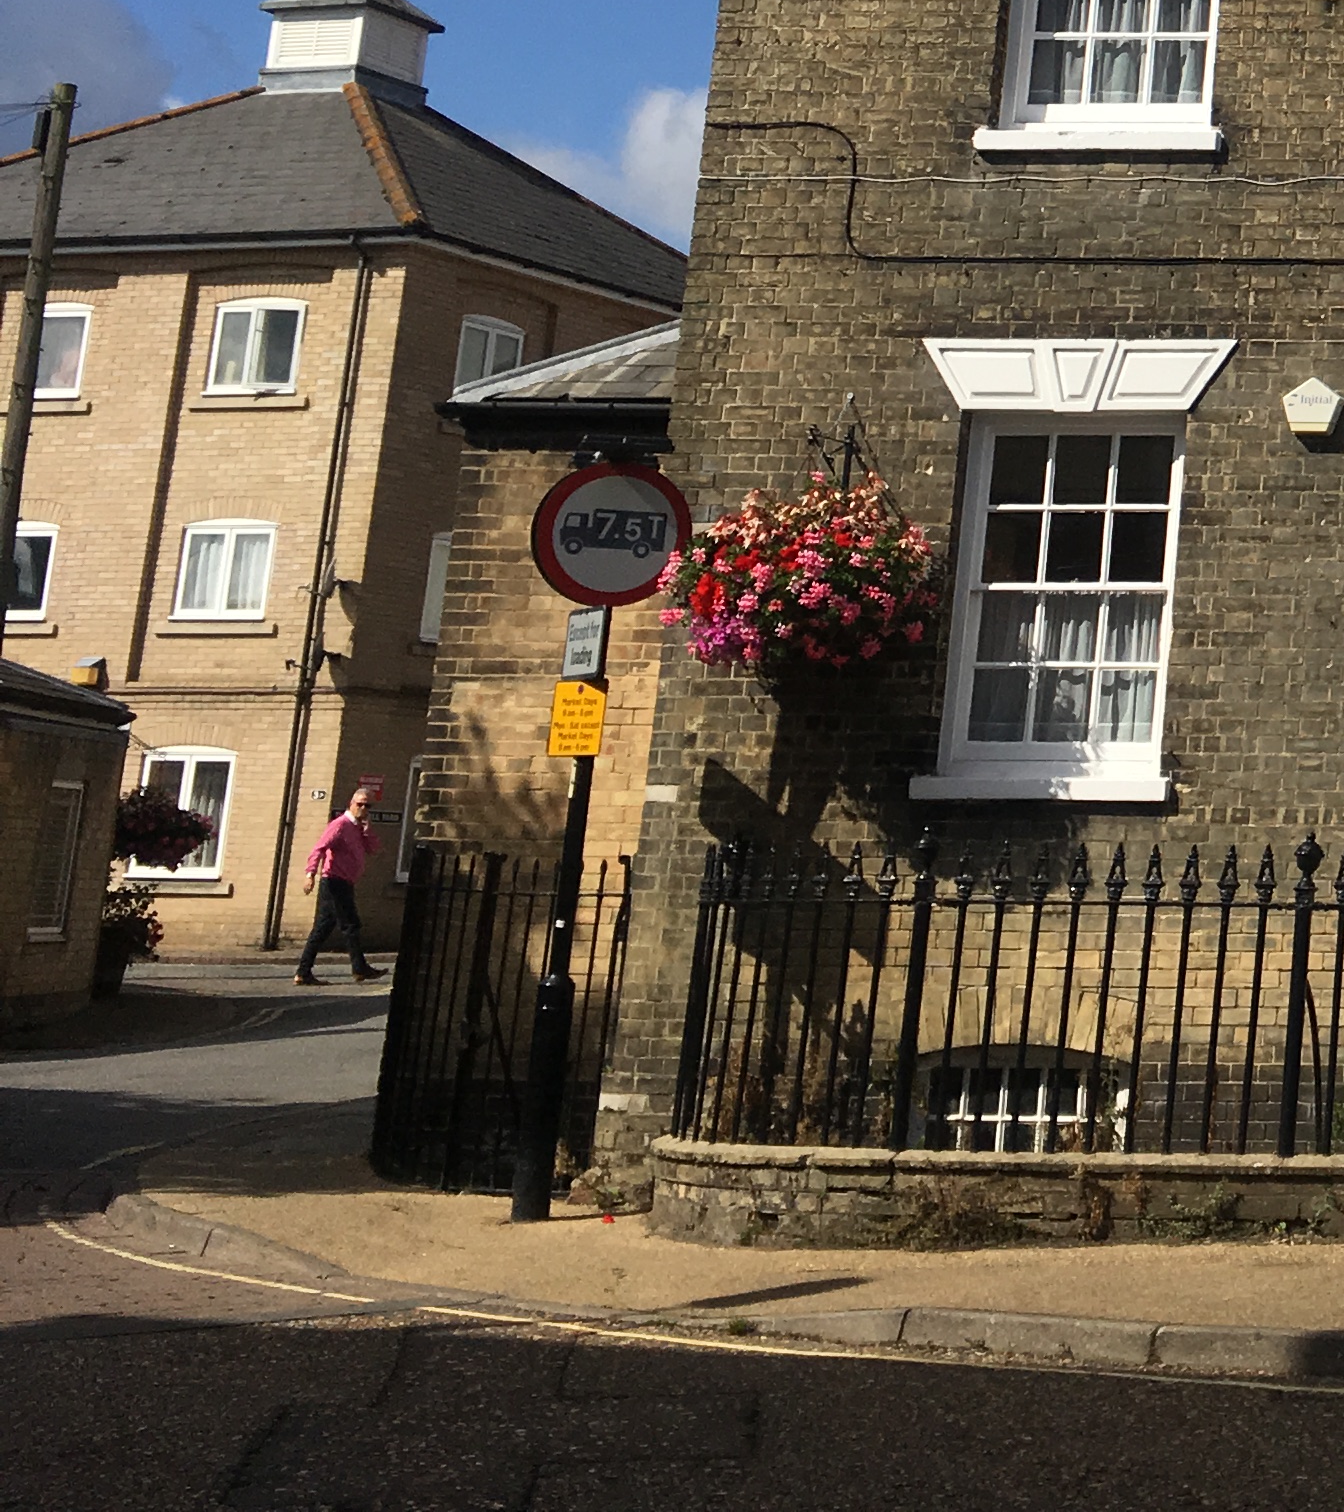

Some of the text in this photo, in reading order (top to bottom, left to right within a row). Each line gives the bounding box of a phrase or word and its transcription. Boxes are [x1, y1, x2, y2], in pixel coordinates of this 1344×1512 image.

[1300, 394, 1333, 406] Initial
[569, 620, 600, 642] Except for
[570, 646, 592, 667] loading
